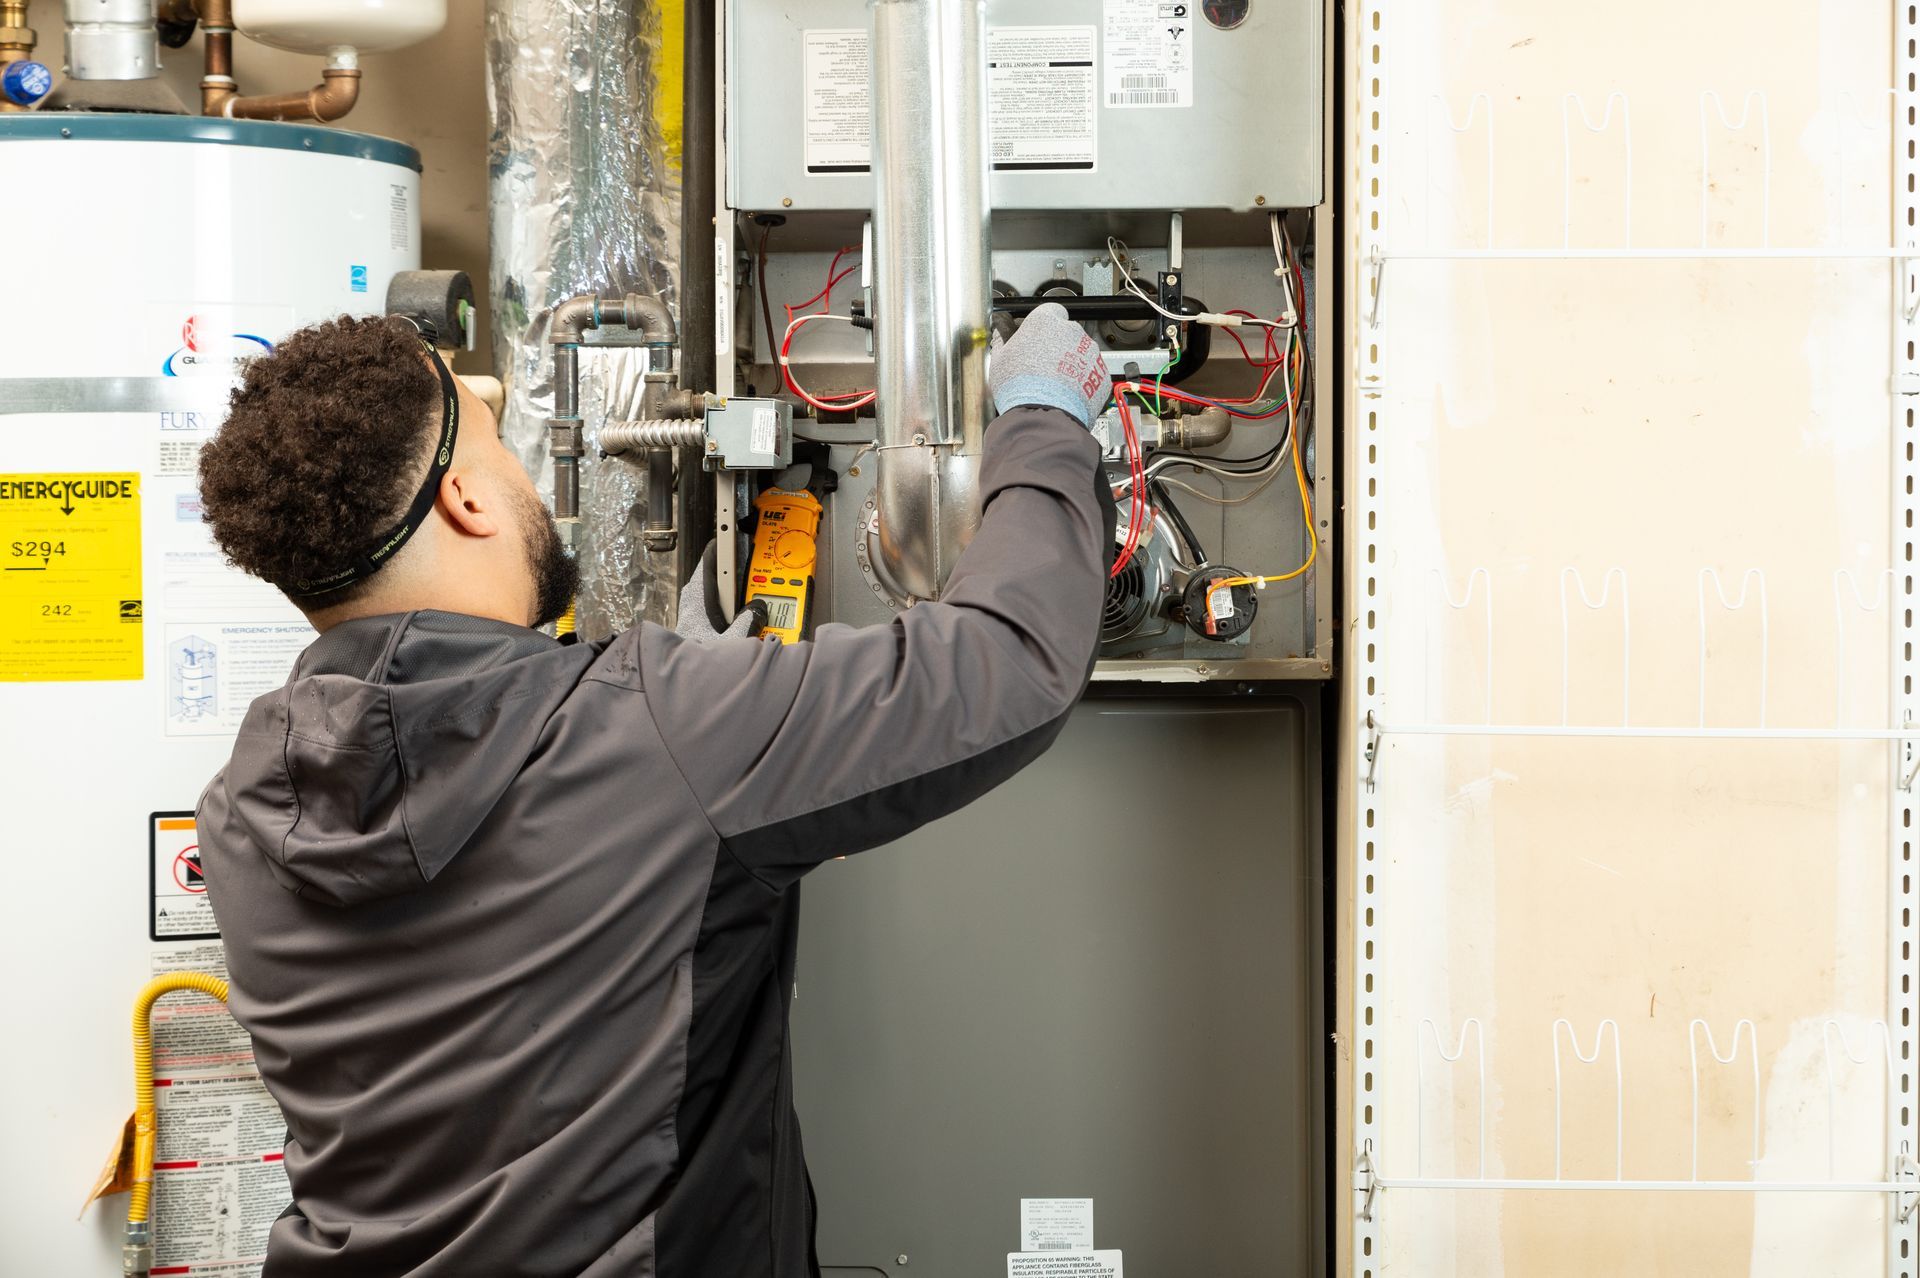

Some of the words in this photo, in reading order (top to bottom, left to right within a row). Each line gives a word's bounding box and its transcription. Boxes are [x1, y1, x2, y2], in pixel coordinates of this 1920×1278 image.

[0, 480, 132, 500] ENERGYGUIDE
[12, 541, 66, 556] $294
[371, 525, 410, 561] TREAMLIGHT
[42, 605, 72, 616] 242
[225, 1158, 261, 1166] INSTRUCTIONS
